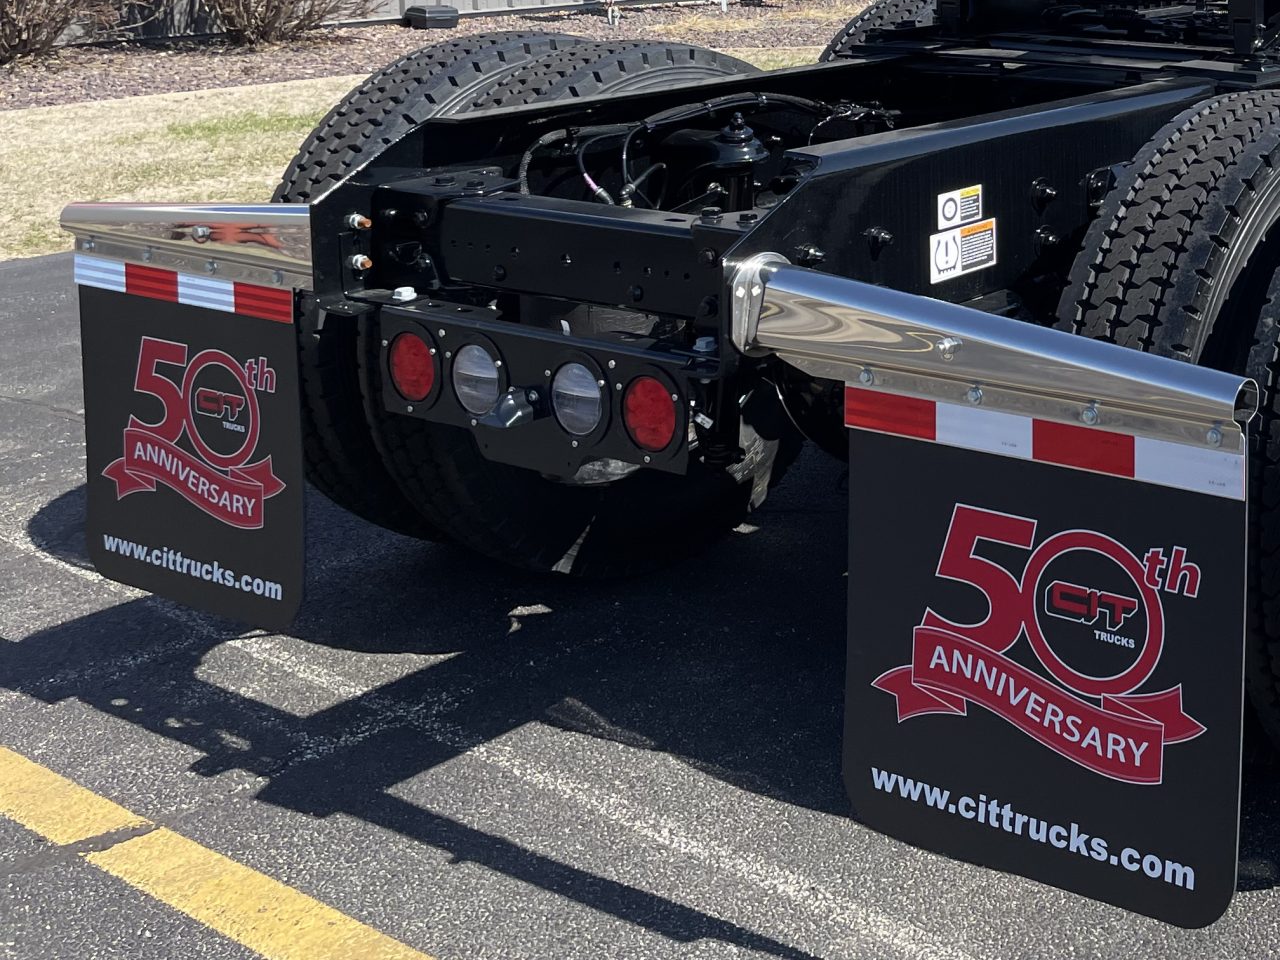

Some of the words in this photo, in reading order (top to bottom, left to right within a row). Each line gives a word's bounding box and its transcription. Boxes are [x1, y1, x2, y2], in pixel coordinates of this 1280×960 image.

[194, 386, 246, 422] CIT
[222, 420, 246, 434] TRUCKS
[133, 441, 257, 518] ANNIVERSARY
[103, 532, 283, 602] www.cittrucks.com
[1044, 579, 1139, 630] CIT
[1094, 628, 1136, 649] TRUCKS
[929, 644, 1150, 768] ANNIVERSARY
[870, 766, 1196, 892] www.cittrucks.com
